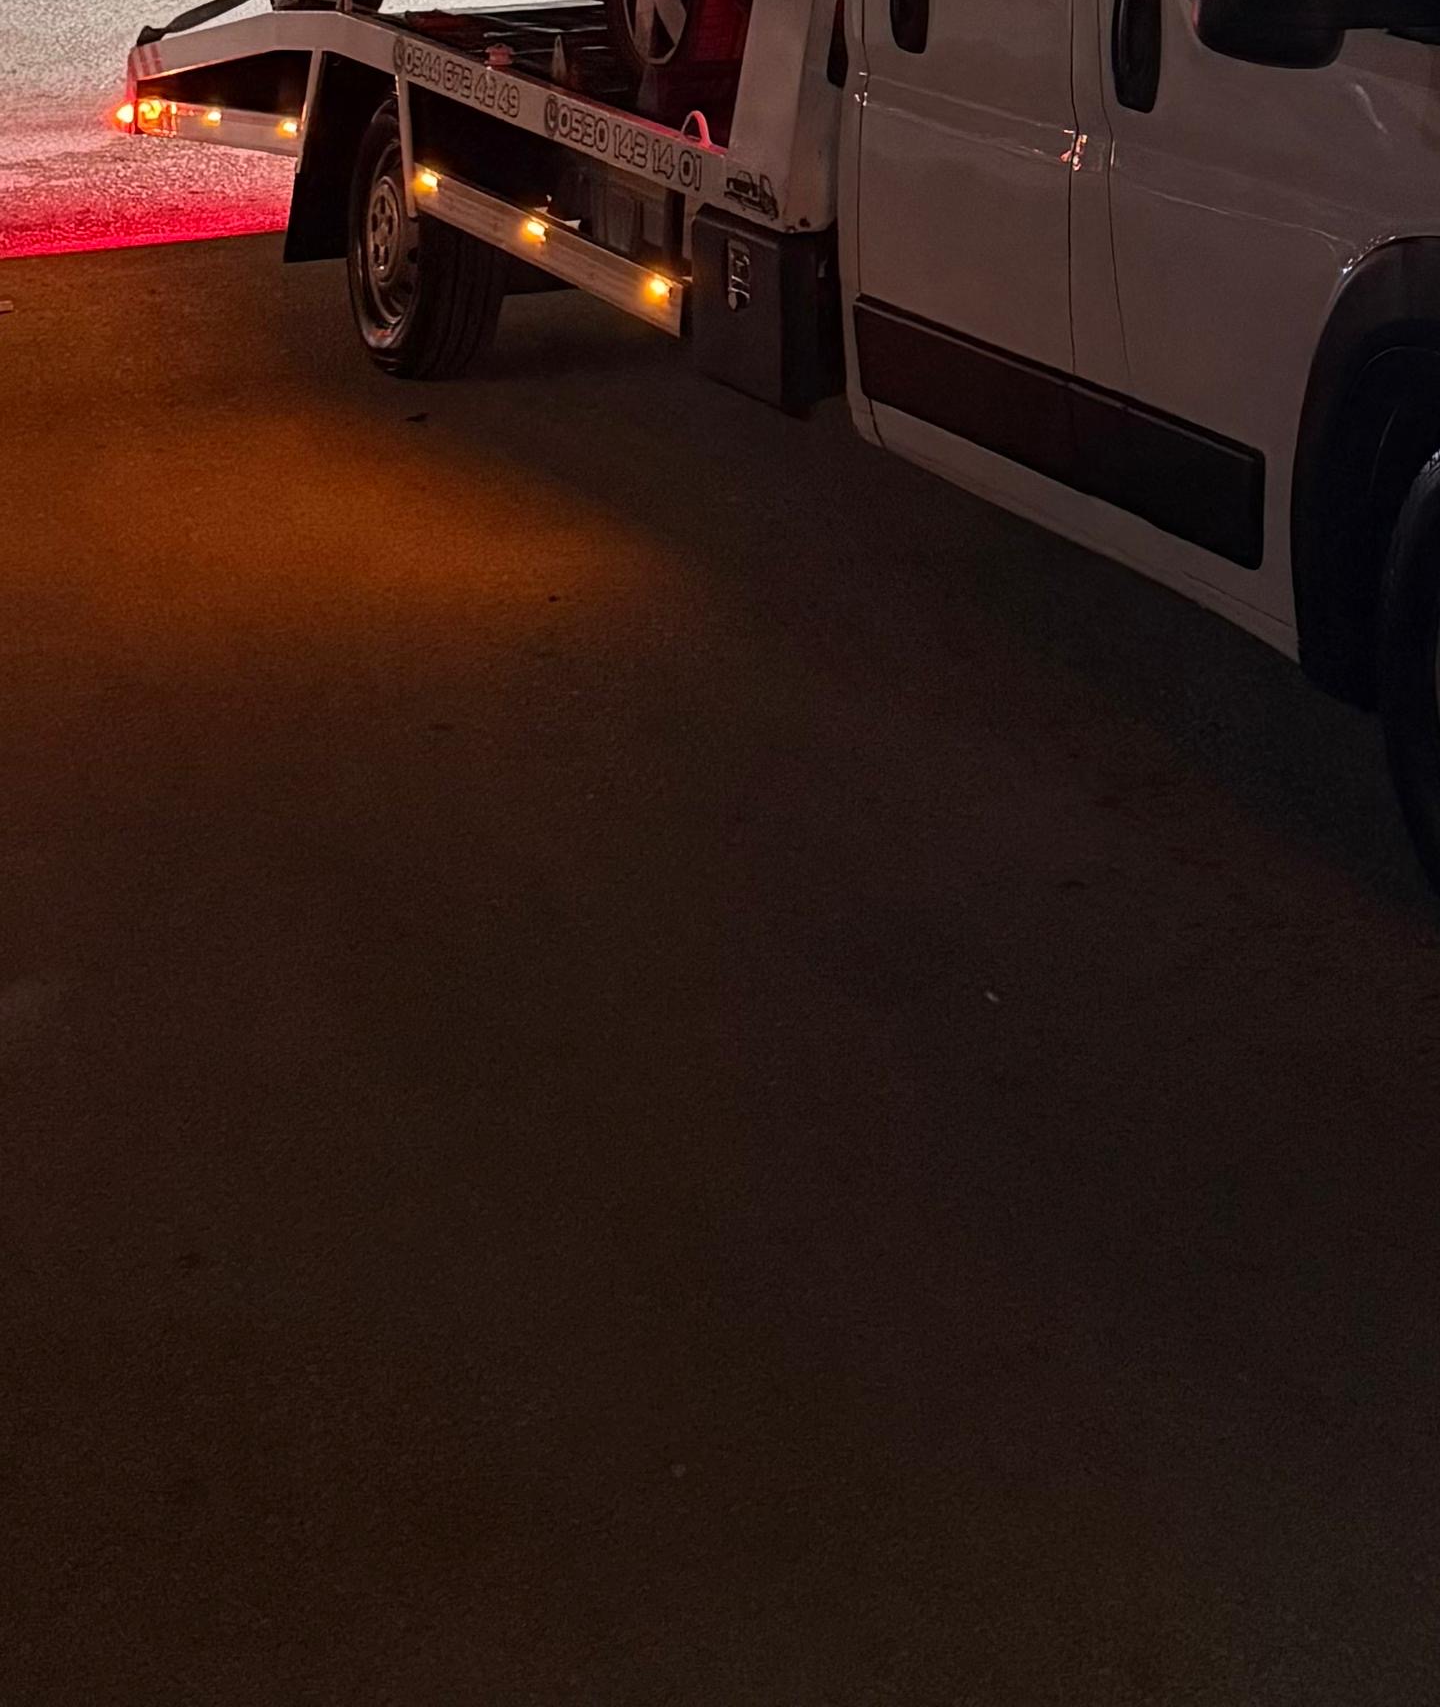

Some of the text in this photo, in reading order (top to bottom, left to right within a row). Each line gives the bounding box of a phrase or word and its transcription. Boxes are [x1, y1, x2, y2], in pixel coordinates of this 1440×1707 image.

[556, 103, 611, 154] 0530
[651, 137, 677, 181] 14
[678, 149, 704, 191] 01
